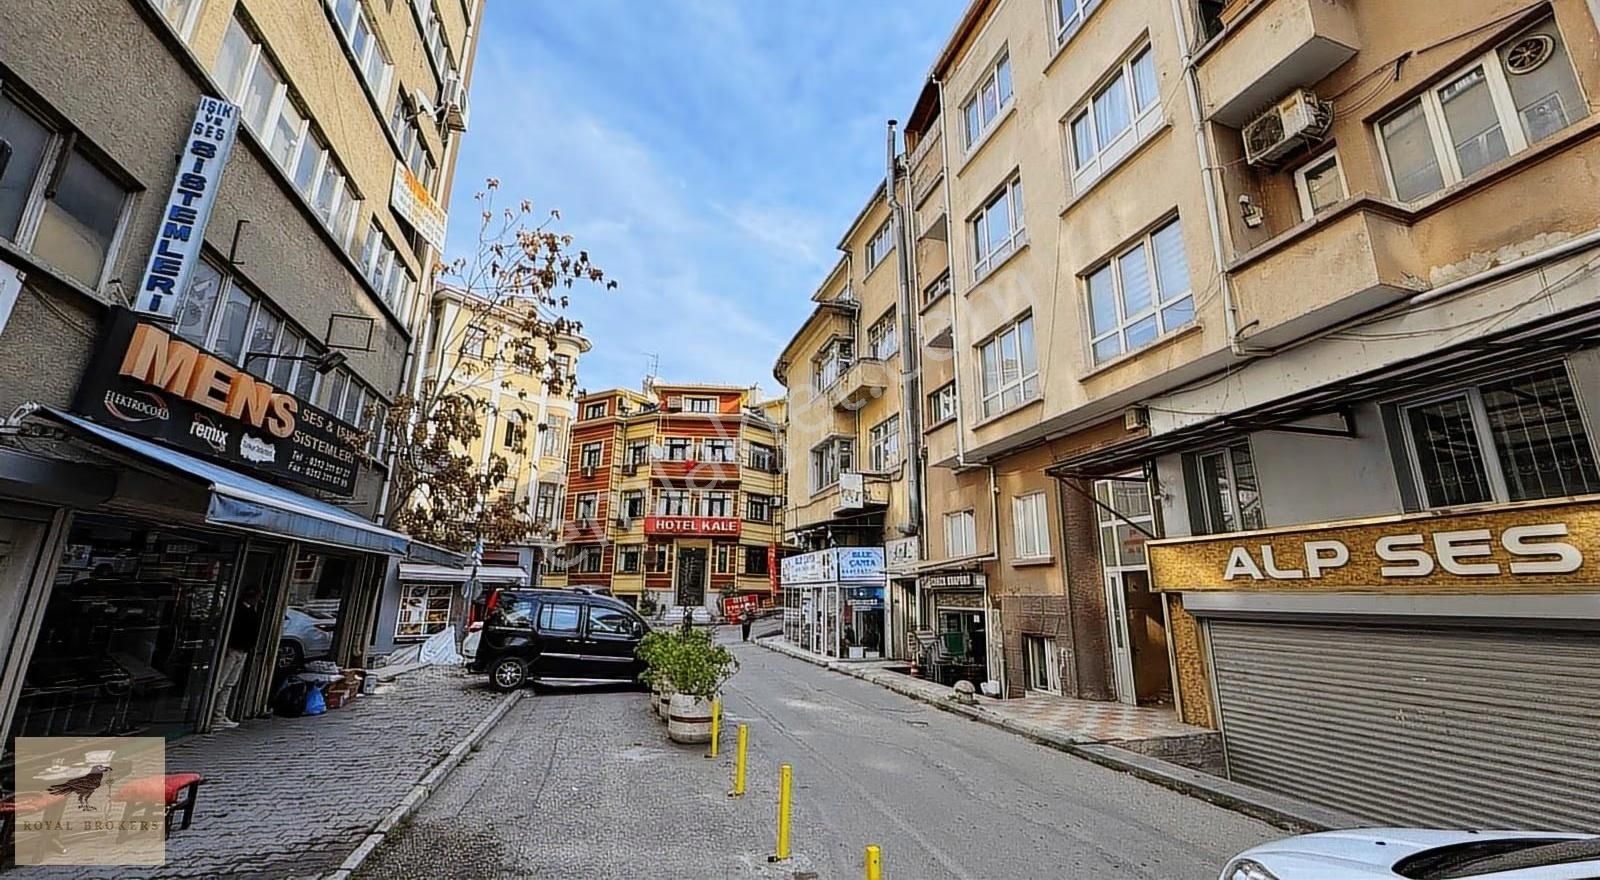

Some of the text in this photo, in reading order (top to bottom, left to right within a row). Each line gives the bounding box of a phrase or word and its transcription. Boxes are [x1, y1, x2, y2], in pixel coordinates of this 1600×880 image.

[201, 98, 232, 118] IŞIK
[193, 122, 226, 141] SES
[118, 323, 298, 438] MENS
[301, 409, 324, 428] SES
[189, 420, 229, 447] remix
[656, 520, 737, 531] HOTEL KALE
[1223, 523, 1584, 580] ALP SES
